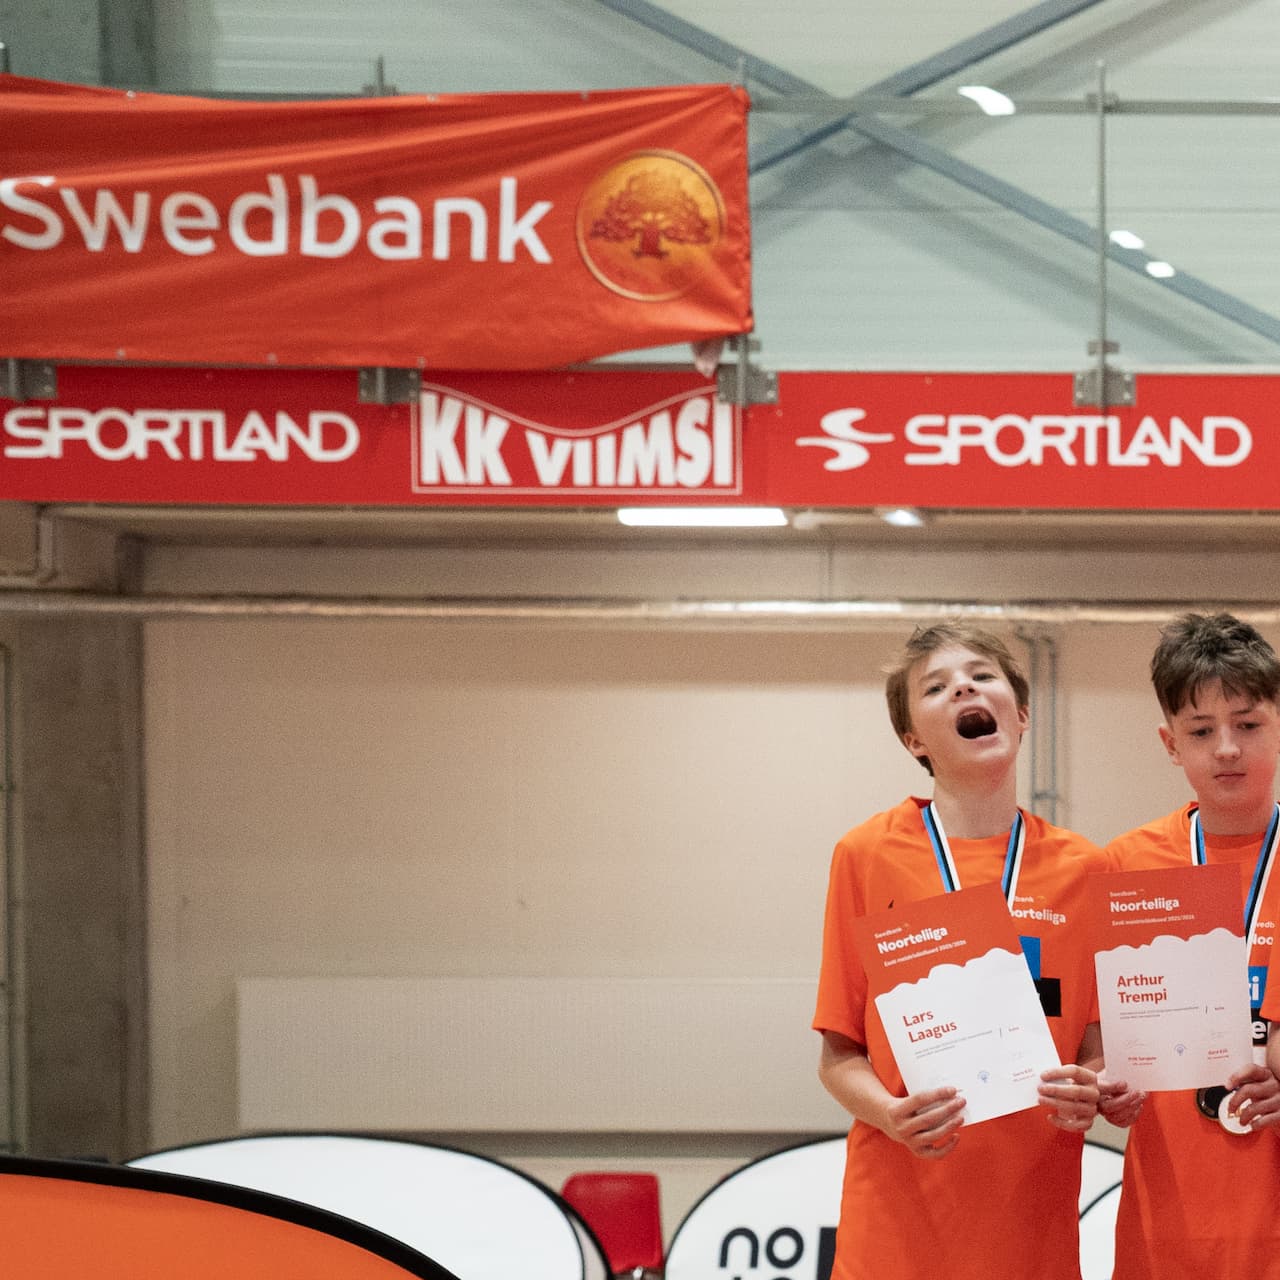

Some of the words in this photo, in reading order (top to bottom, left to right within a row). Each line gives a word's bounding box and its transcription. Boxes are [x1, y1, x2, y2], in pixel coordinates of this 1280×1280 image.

[0, 174, 554, 264] Swedbank
[3, 408, 361, 462] SPORTLAND
[420, 395, 511, 487] KK
[526, 394, 734, 488] VIIMSI
[904, 414, 1253, 468] SPORTLAND
[1110, 897, 1180, 913] Noorteliiga
[1011, 909, 1066, 925] orteliiga
[877, 926, 948, 954] Noorteliiga
[1117, 974, 1165, 989] Arthur
[1117, 989, 1168, 1005] Trempi
[902, 1010, 934, 1027] Lars
[908, 1021, 957, 1044] Laagus
